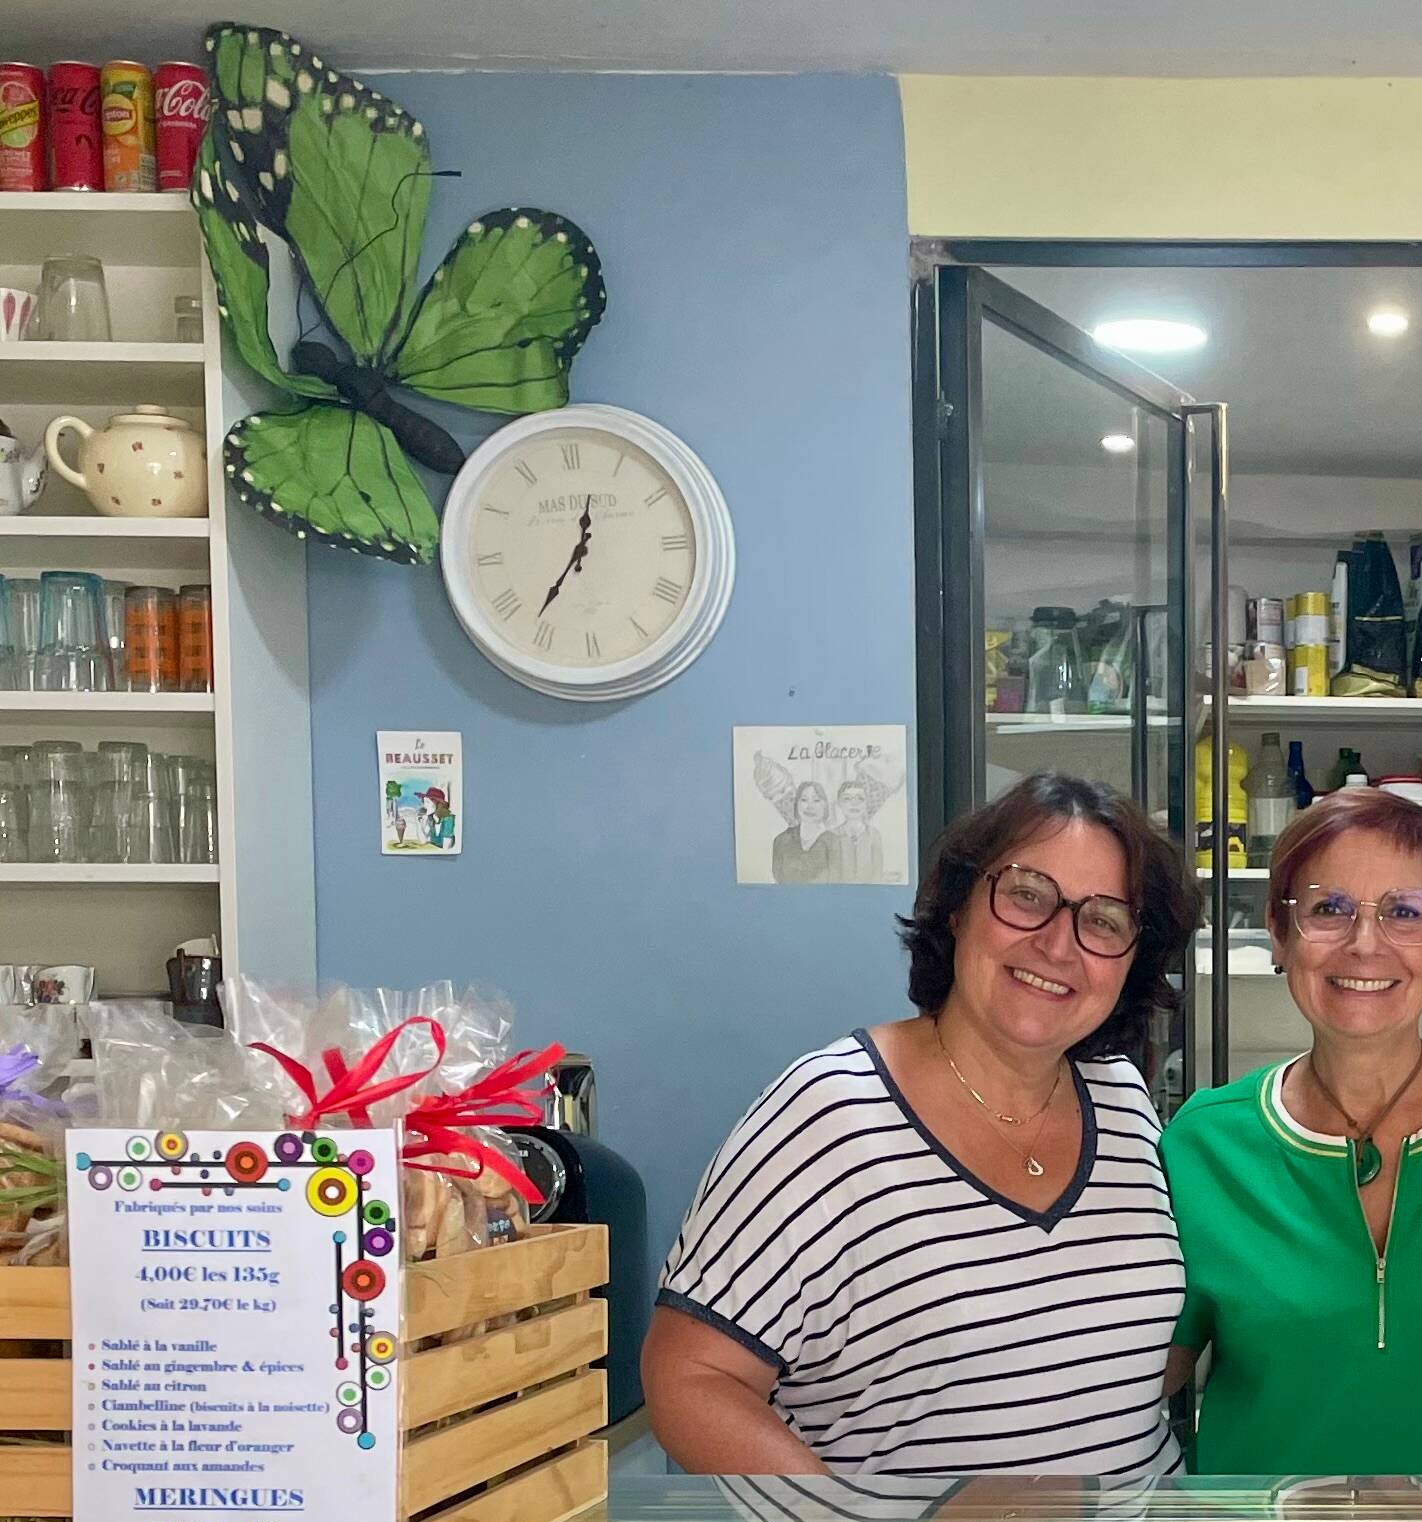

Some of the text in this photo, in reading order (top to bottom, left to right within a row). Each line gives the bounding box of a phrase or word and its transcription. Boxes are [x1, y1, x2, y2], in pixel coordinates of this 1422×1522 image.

[539, 496, 565, 513] MAS
[386, 754, 453, 764] BEAUSSET
[788, 747, 810, 760] La
[114, 1200, 282, 1215] Fabriqués par nos soins
[143, 1229, 271, 1249] BISCUITS
[202, 1267, 226, 1282] les
[233, 1267, 280, 1285] 135g
[141, 1299, 175, 1312] (Soit
[236, 1299, 249, 1310] le
[254, 1299, 276, 1313] kg)
[102, 1340, 217, 1352] Sablé à la vanille
[102, 1360, 304, 1374] Sablé au gingembre & épices
[102, 1380, 207, 1392] Sablé au citron
[102, 1400, 330, 1413] Ciambelline (biscuits à la noisette)
[102, 1420, 242, 1432] Cookies à la lavande
[103, 1441, 156, 1451] Navette
[160, 1441, 169, 1451] à
[172, 1441, 185, 1451] la
[188, 1440, 222, 1452] fleur
[102, 1461, 264, 1473] Croquant aux amandes
[135, 1488, 304, 1506] MERINGUES
